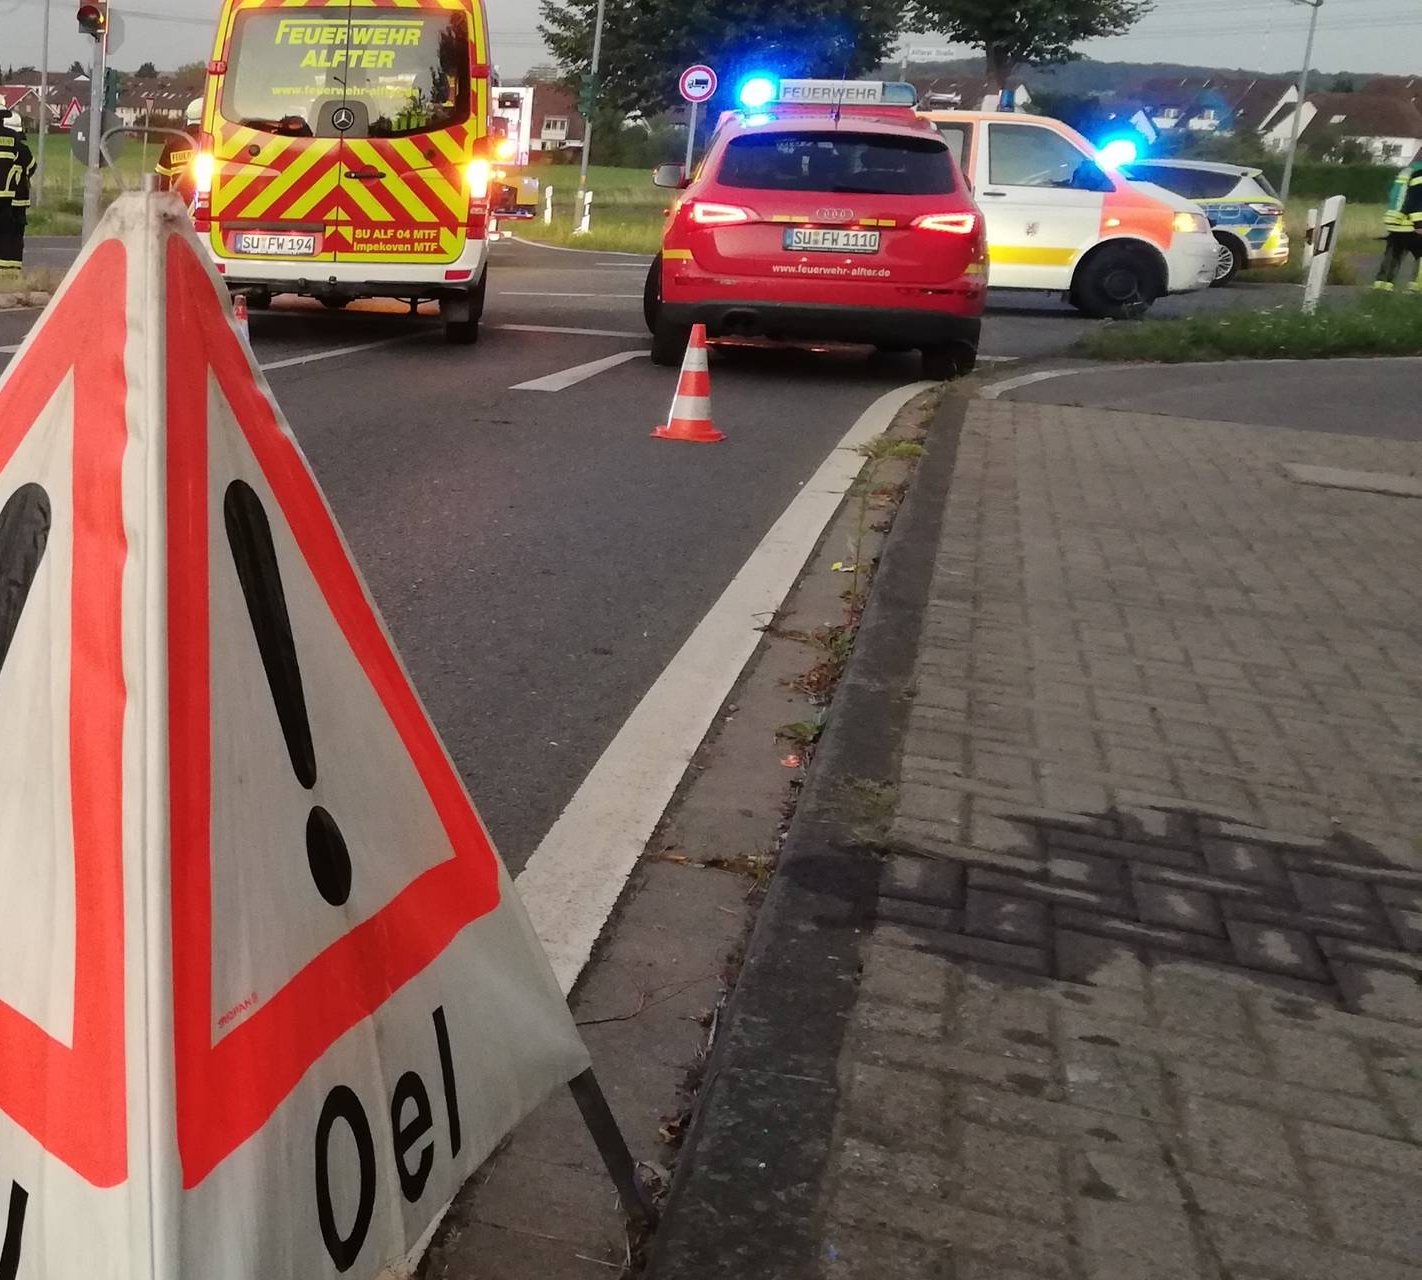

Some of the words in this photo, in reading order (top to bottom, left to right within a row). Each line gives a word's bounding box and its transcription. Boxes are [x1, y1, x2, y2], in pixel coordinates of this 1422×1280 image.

[275, 19, 424, 45] FEUERWEHR
[299, 49, 396, 68] ALFTER
[783, 87, 877, 100] FEUERWEHR
[355, 229, 369, 239] SU
[373, 230, 393, 239] ALF
[397, 230, 411, 239] 04
[413, 230, 438, 239] MTF
[794, 231, 811, 245] SU
[821, 232, 840, 246] FW
[842, 233, 877, 247] 1110
[243, 236, 260, 249] SU
[267, 238, 286, 250] FW
[289, 238, 312, 251] 194
[354, 242, 411, 252] Impekoven
[413, 242, 438, 252] MTF
[315, 1005, 461, 1273] Oel
